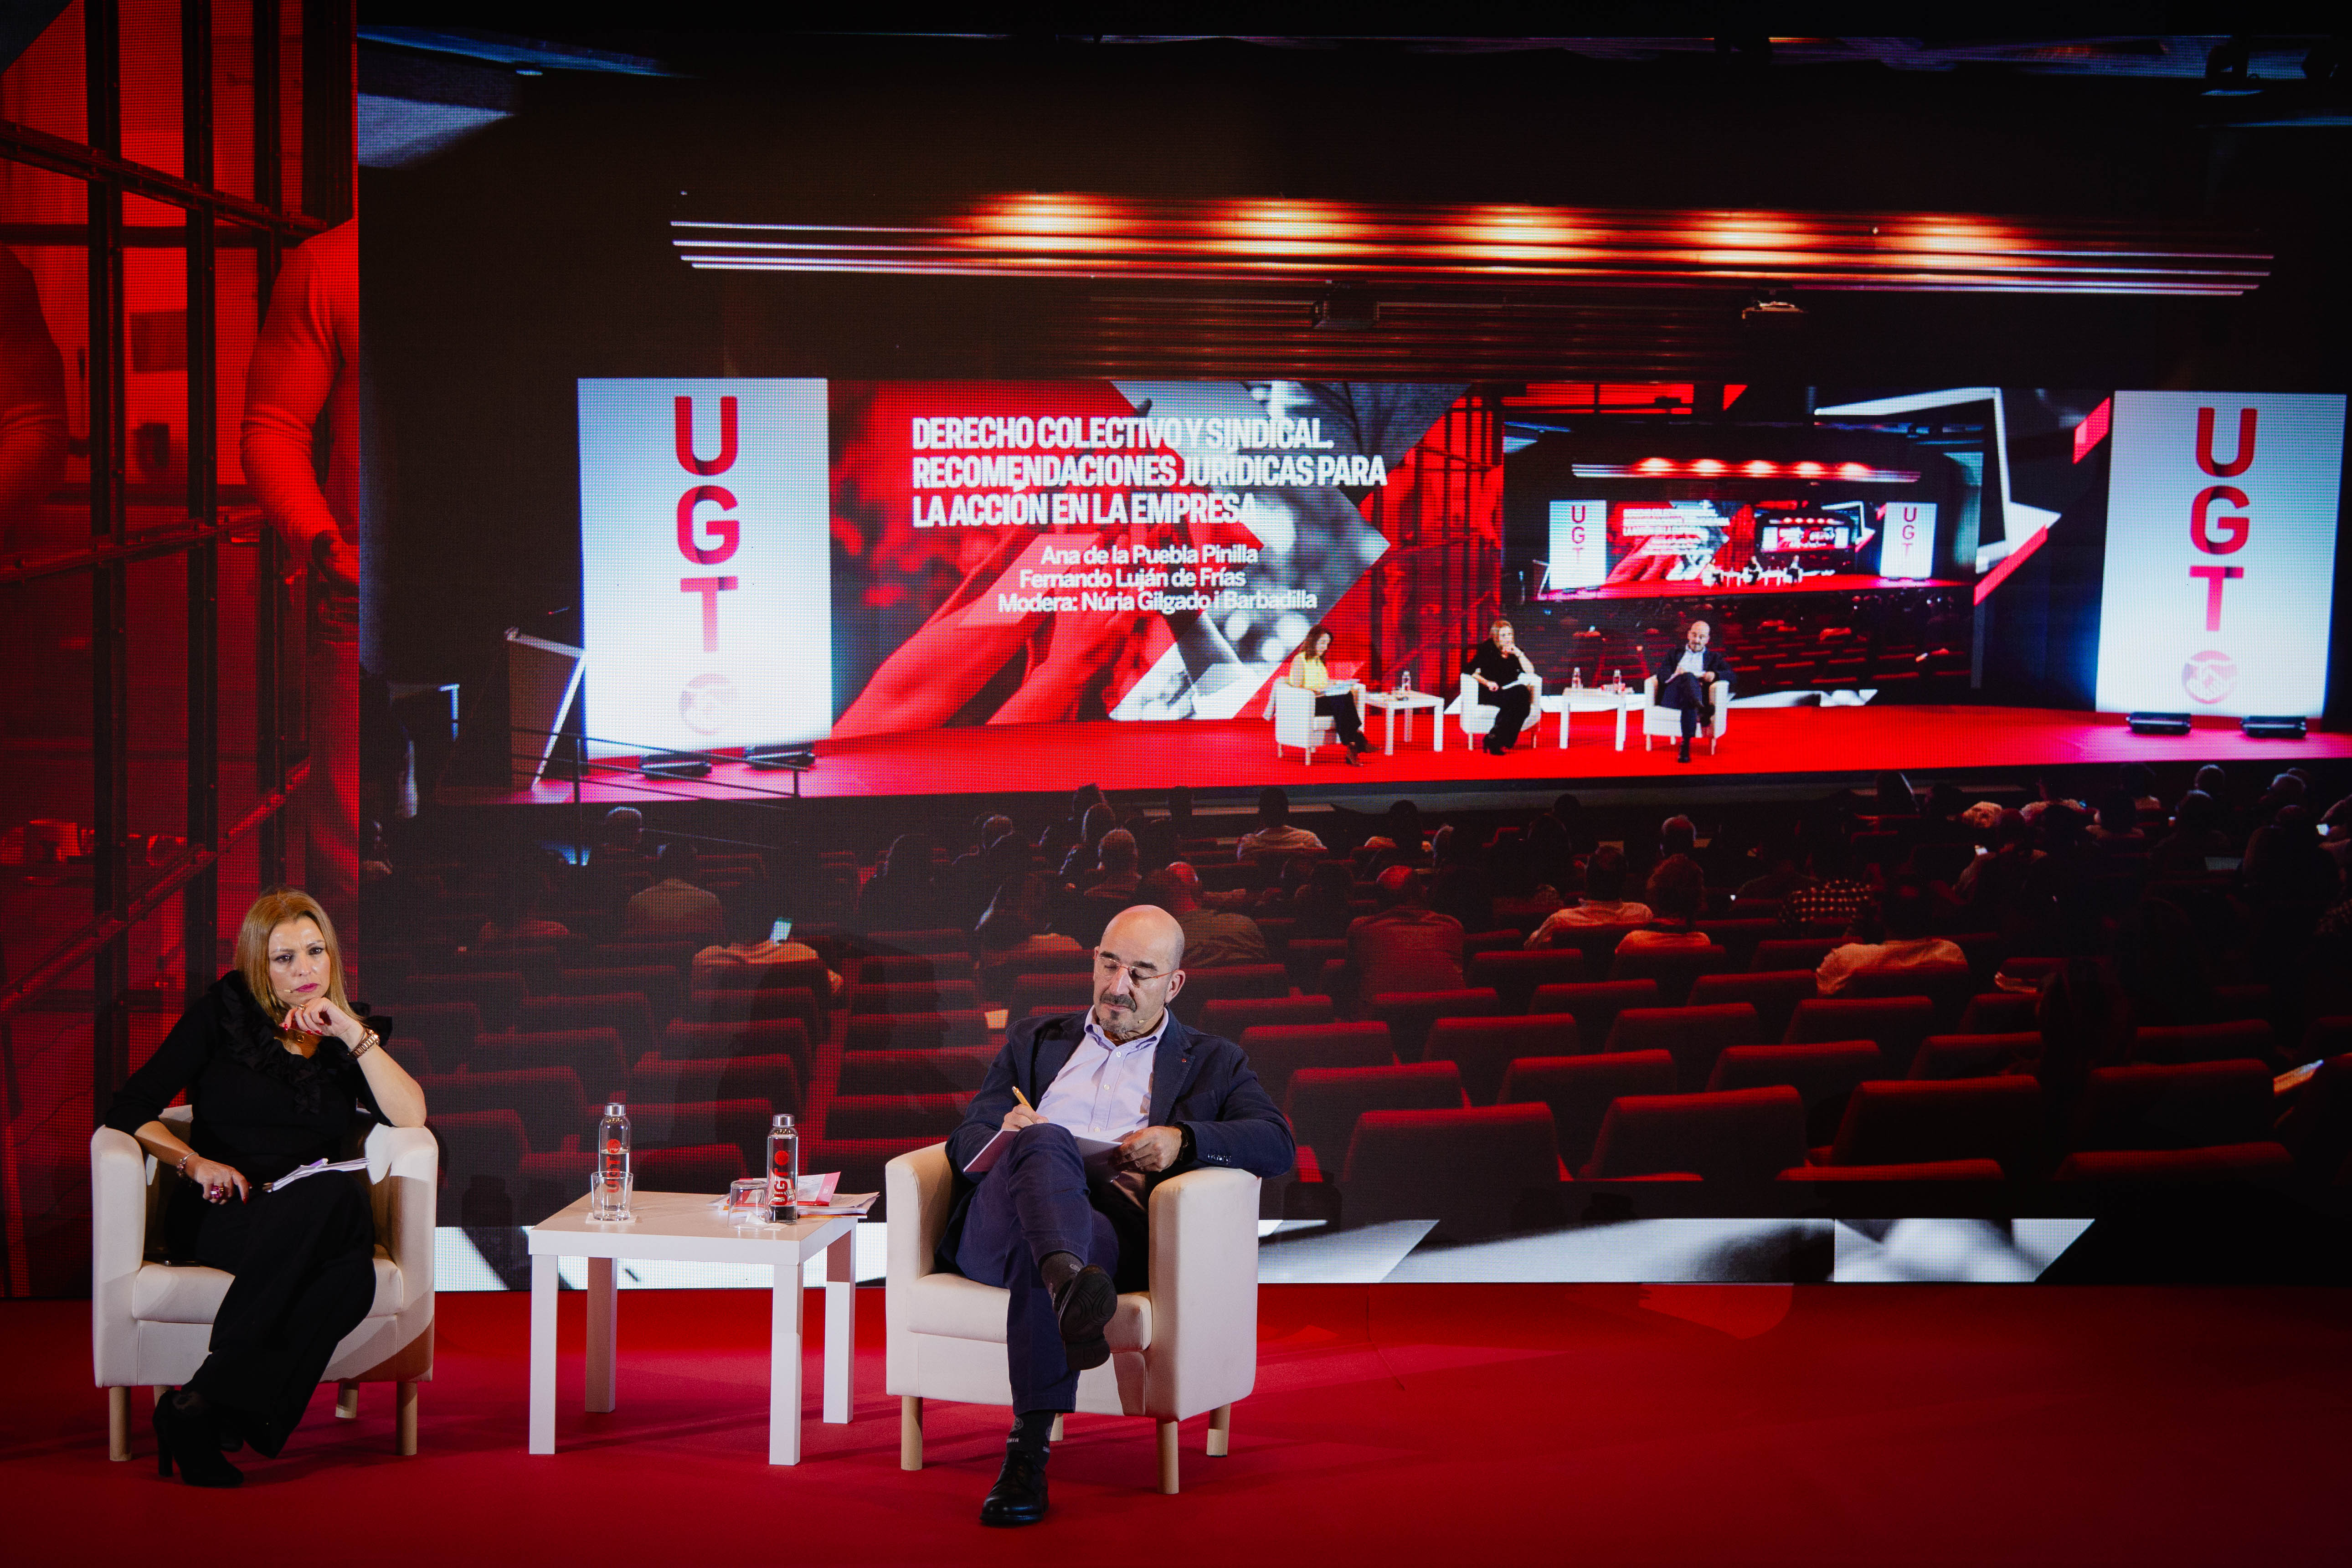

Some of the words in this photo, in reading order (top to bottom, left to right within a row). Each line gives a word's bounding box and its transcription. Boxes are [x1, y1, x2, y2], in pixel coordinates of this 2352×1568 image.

[912, 416, 1034, 449] DERECHO
[1038, 416, 1181, 448] COLECTIVO
[1184, 418, 1204, 448] Y
[1206, 418, 1334, 448] SINDICAL.
[913, 455, 1177, 488] RECOMENDACIONES
[1318, 455, 1388, 486] PARA
[674, 396, 740, 652] UGT
[912, 496, 947, 528] LA
[1052, 493, 1088, 524] EN
[1093, 493, 1129, 524] LA
[1131, 492, 1257, 524] EMPRESA
[2189, 407, 2258, 632] UGT
[1041, 545, 1081, 565] Ana
[1083, 545, 1109, 565] de
[1112, 545, 1129, 565] la
[1133, 544, 1198, 564] Puebla
[1202, 543, 1259, 563] Pinilla
[1020, 568, 1112, 588] Fernando
[1116, 567, 1168, 591] Luján
[1171, 567, 1196, 587] de
[1200, 566, 1247, 587] Frías
[998, 593, 1078, 612] Modera:
[1081, 591, 1135, 611] Núria
[1137, 590, 1211, 615] Gilgado
[1214, 590, 1220, 609] i
[1224, 589, 1318, 609] Barbadilla
[606, 1156, 621, 1193] UGT
[774, 1168, 788, 1206] UGT
